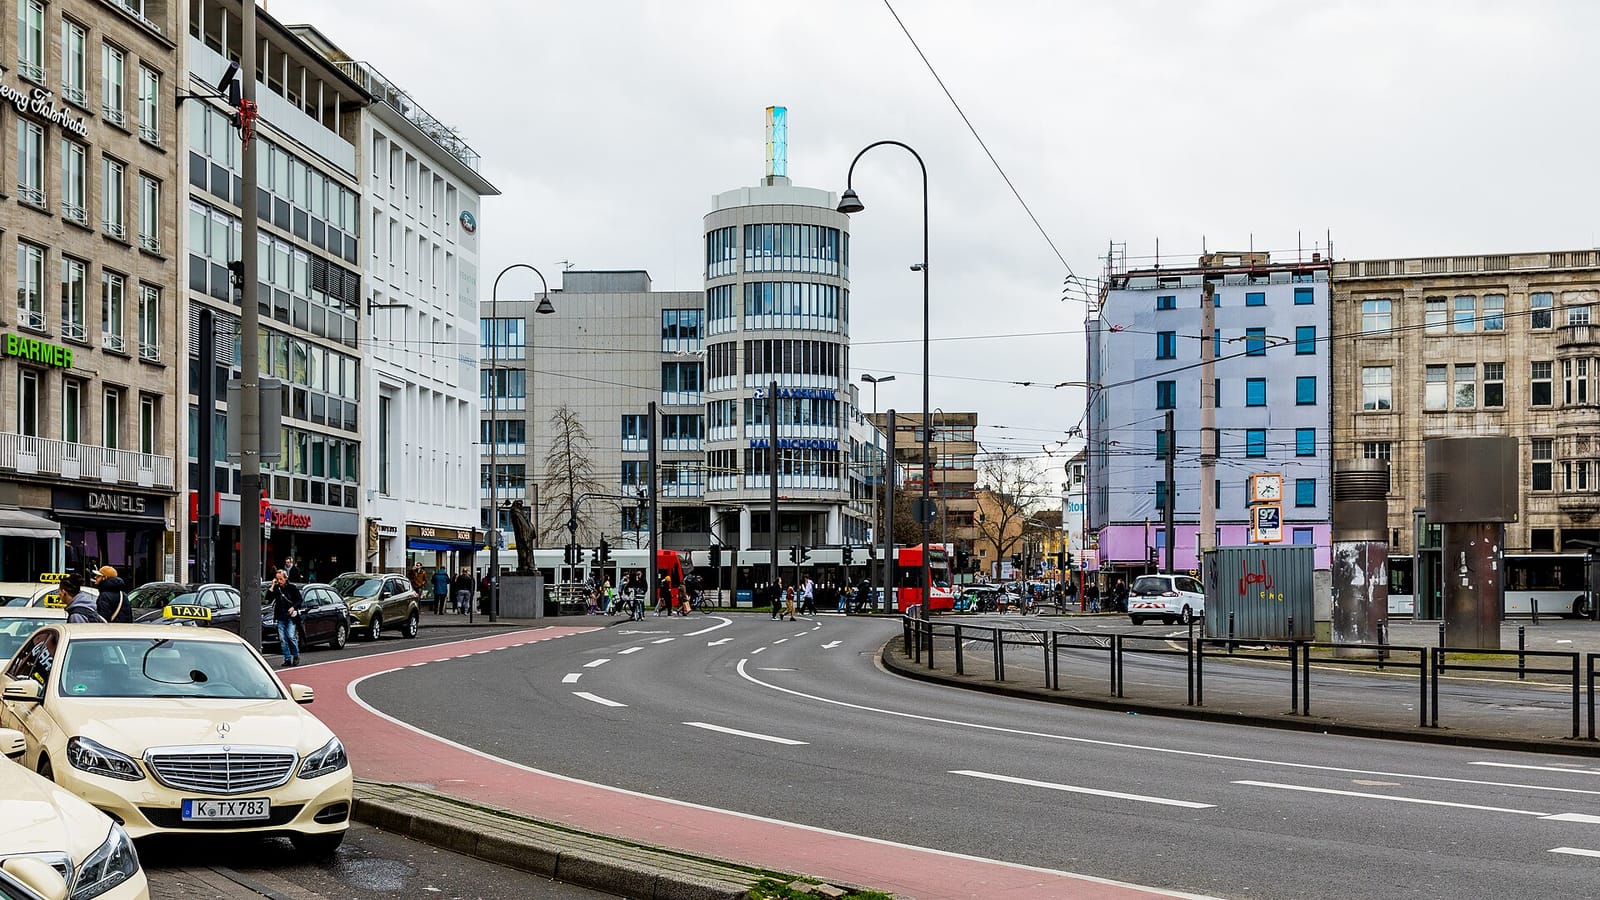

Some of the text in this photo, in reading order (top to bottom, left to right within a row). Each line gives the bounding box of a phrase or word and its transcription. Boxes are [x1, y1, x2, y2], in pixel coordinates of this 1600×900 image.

[0, 69, 28, 112] eorg
[7, 333, 73, 369] BARMER
[88, 492, 145, 513] DANIELS
[272, 507, 311, 529] Sparkasse
[1260, 509, 1275, 520] 97
[174, 606, 205, 617] TAXI
[197, 802, 207, 816] K
